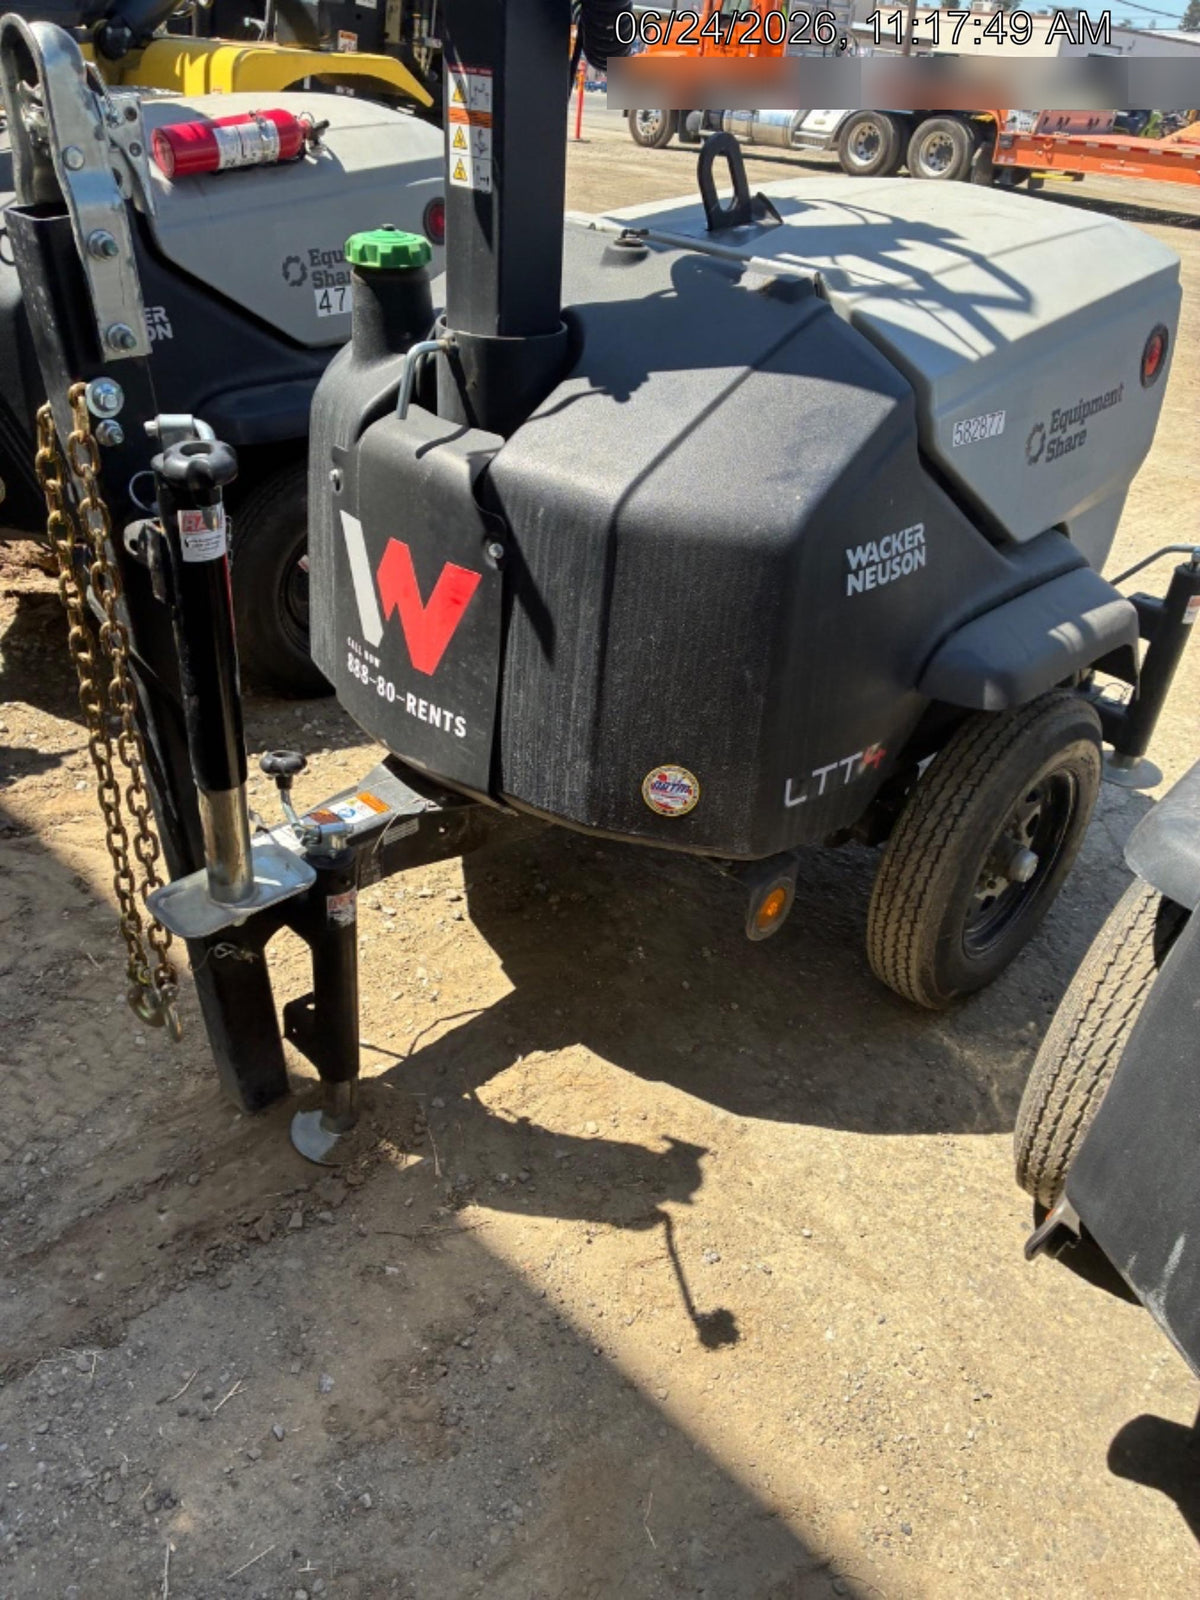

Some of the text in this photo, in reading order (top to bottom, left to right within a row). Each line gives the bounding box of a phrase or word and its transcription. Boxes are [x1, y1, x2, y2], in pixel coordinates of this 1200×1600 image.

[308, 248, 345, 268] Equ
[143, 306, 169, 323] ER
[319, 289, 346, 313] 47
[146, 323, 173, 341] ON
[1050, 382, 1124, 434] Equipment
[953, 411, 1005, 446] 582877
[1045, 429, 1087, 463] Share
[845, 522, 926, 570] WACKER
[846, 545, 926, 596] NEUSON
[347, 652, 467, 738] 888-80-RENTS
